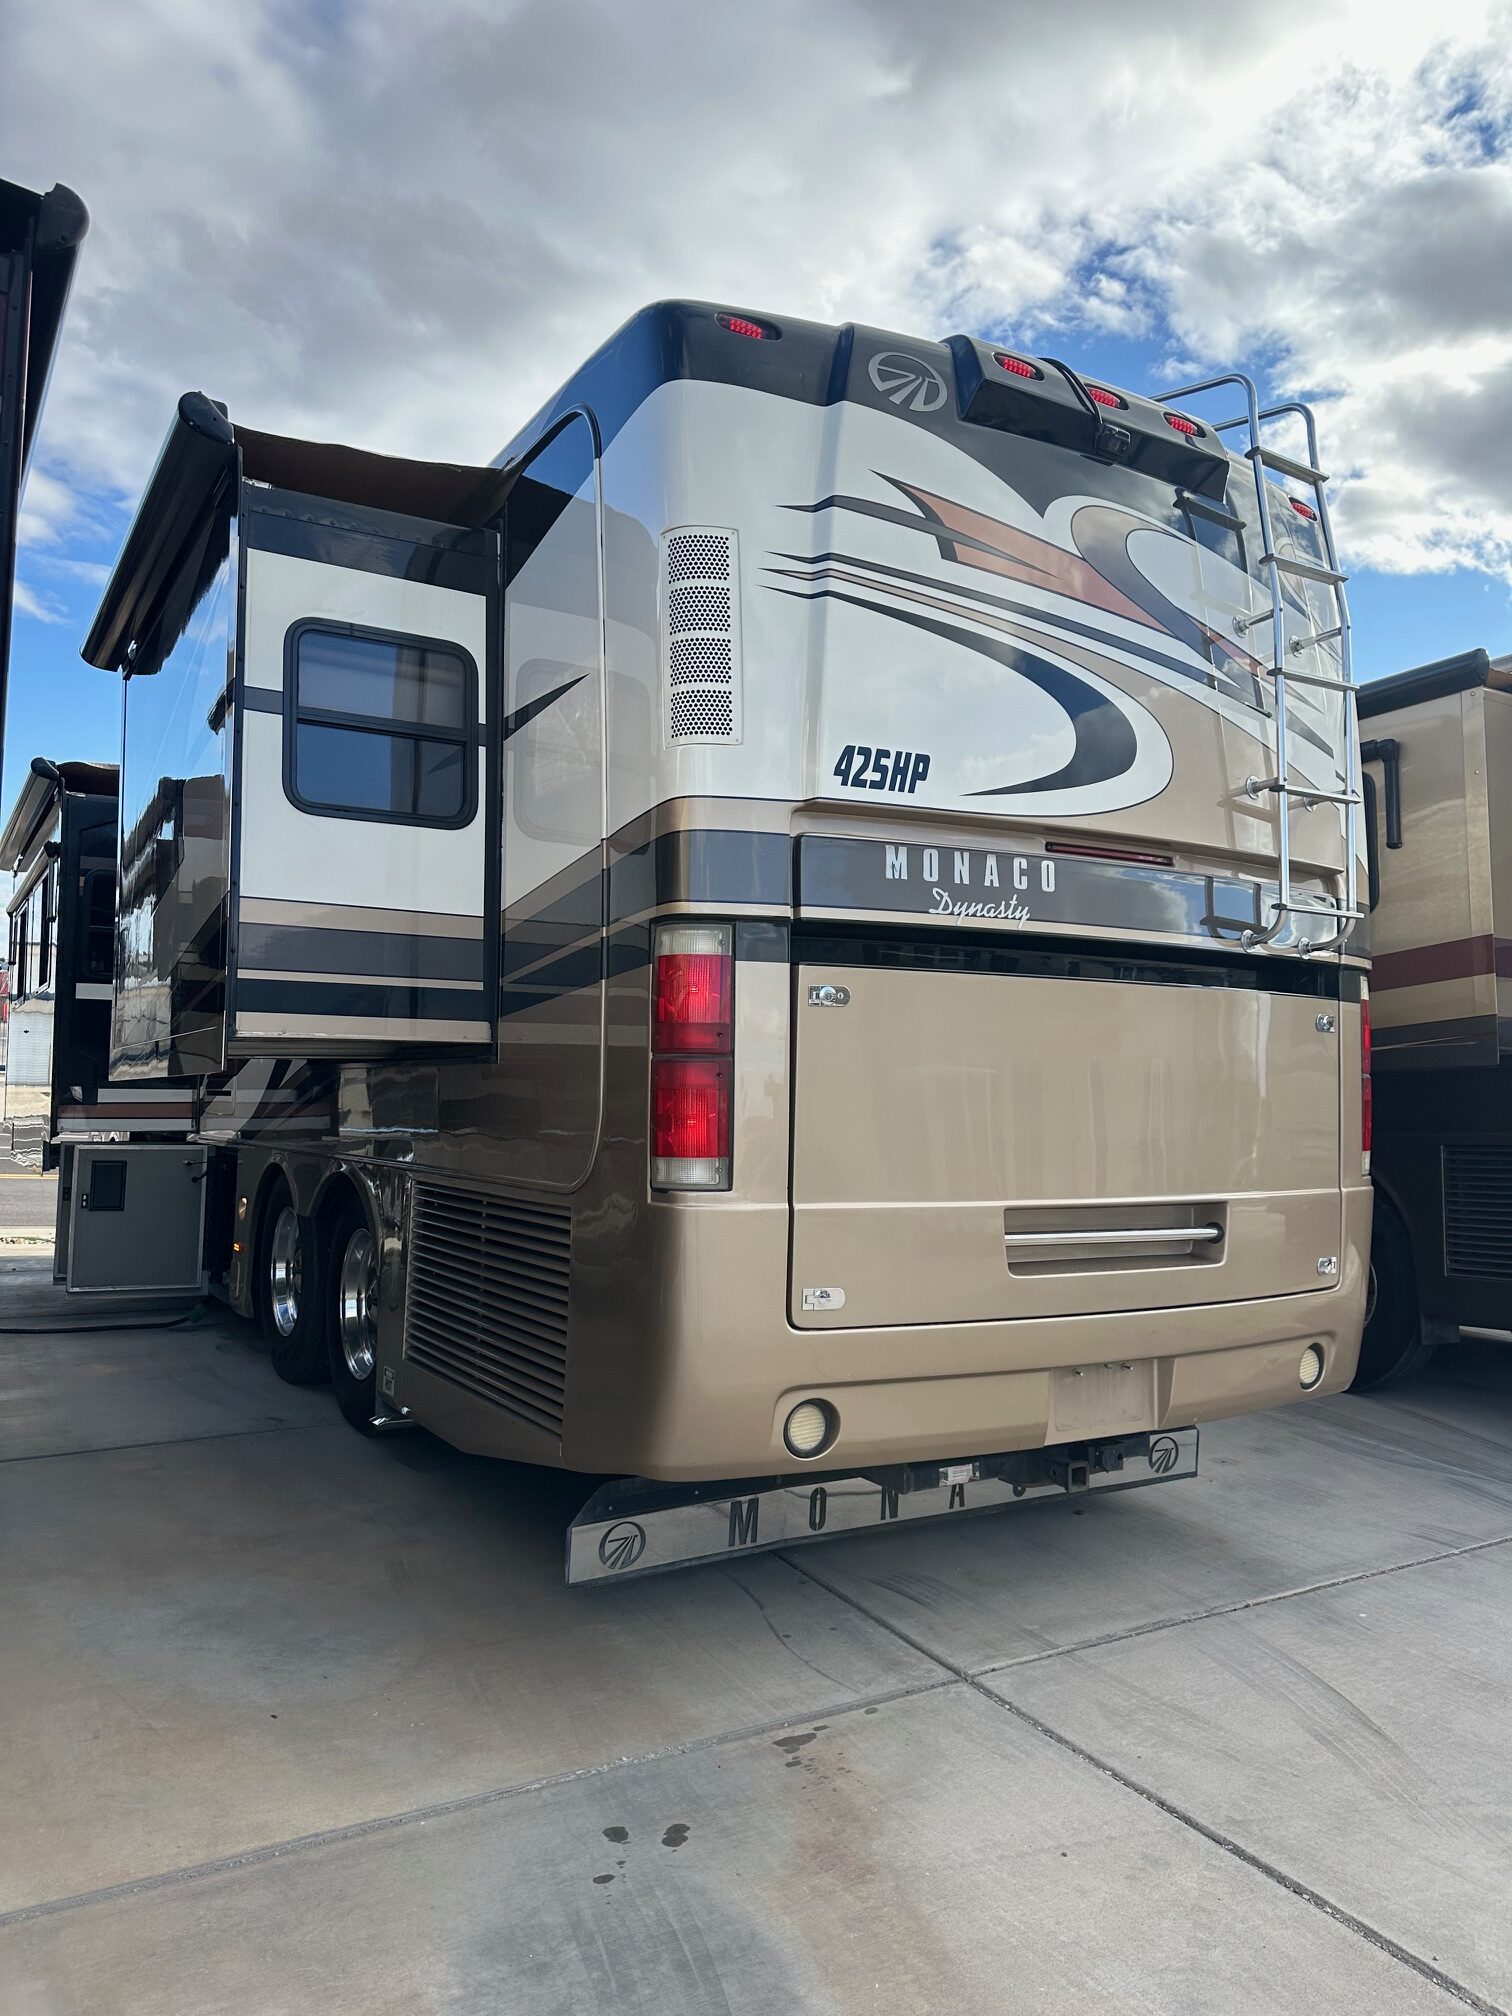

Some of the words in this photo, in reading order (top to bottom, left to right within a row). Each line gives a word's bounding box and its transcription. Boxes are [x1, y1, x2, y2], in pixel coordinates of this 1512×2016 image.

[833, 745, 930, 794] 425HP
[885, 845, 1055, 892] MONACO
[928, 887, 1031, 929] Dynasty
[728, 1482, 966, 1548] MONA
